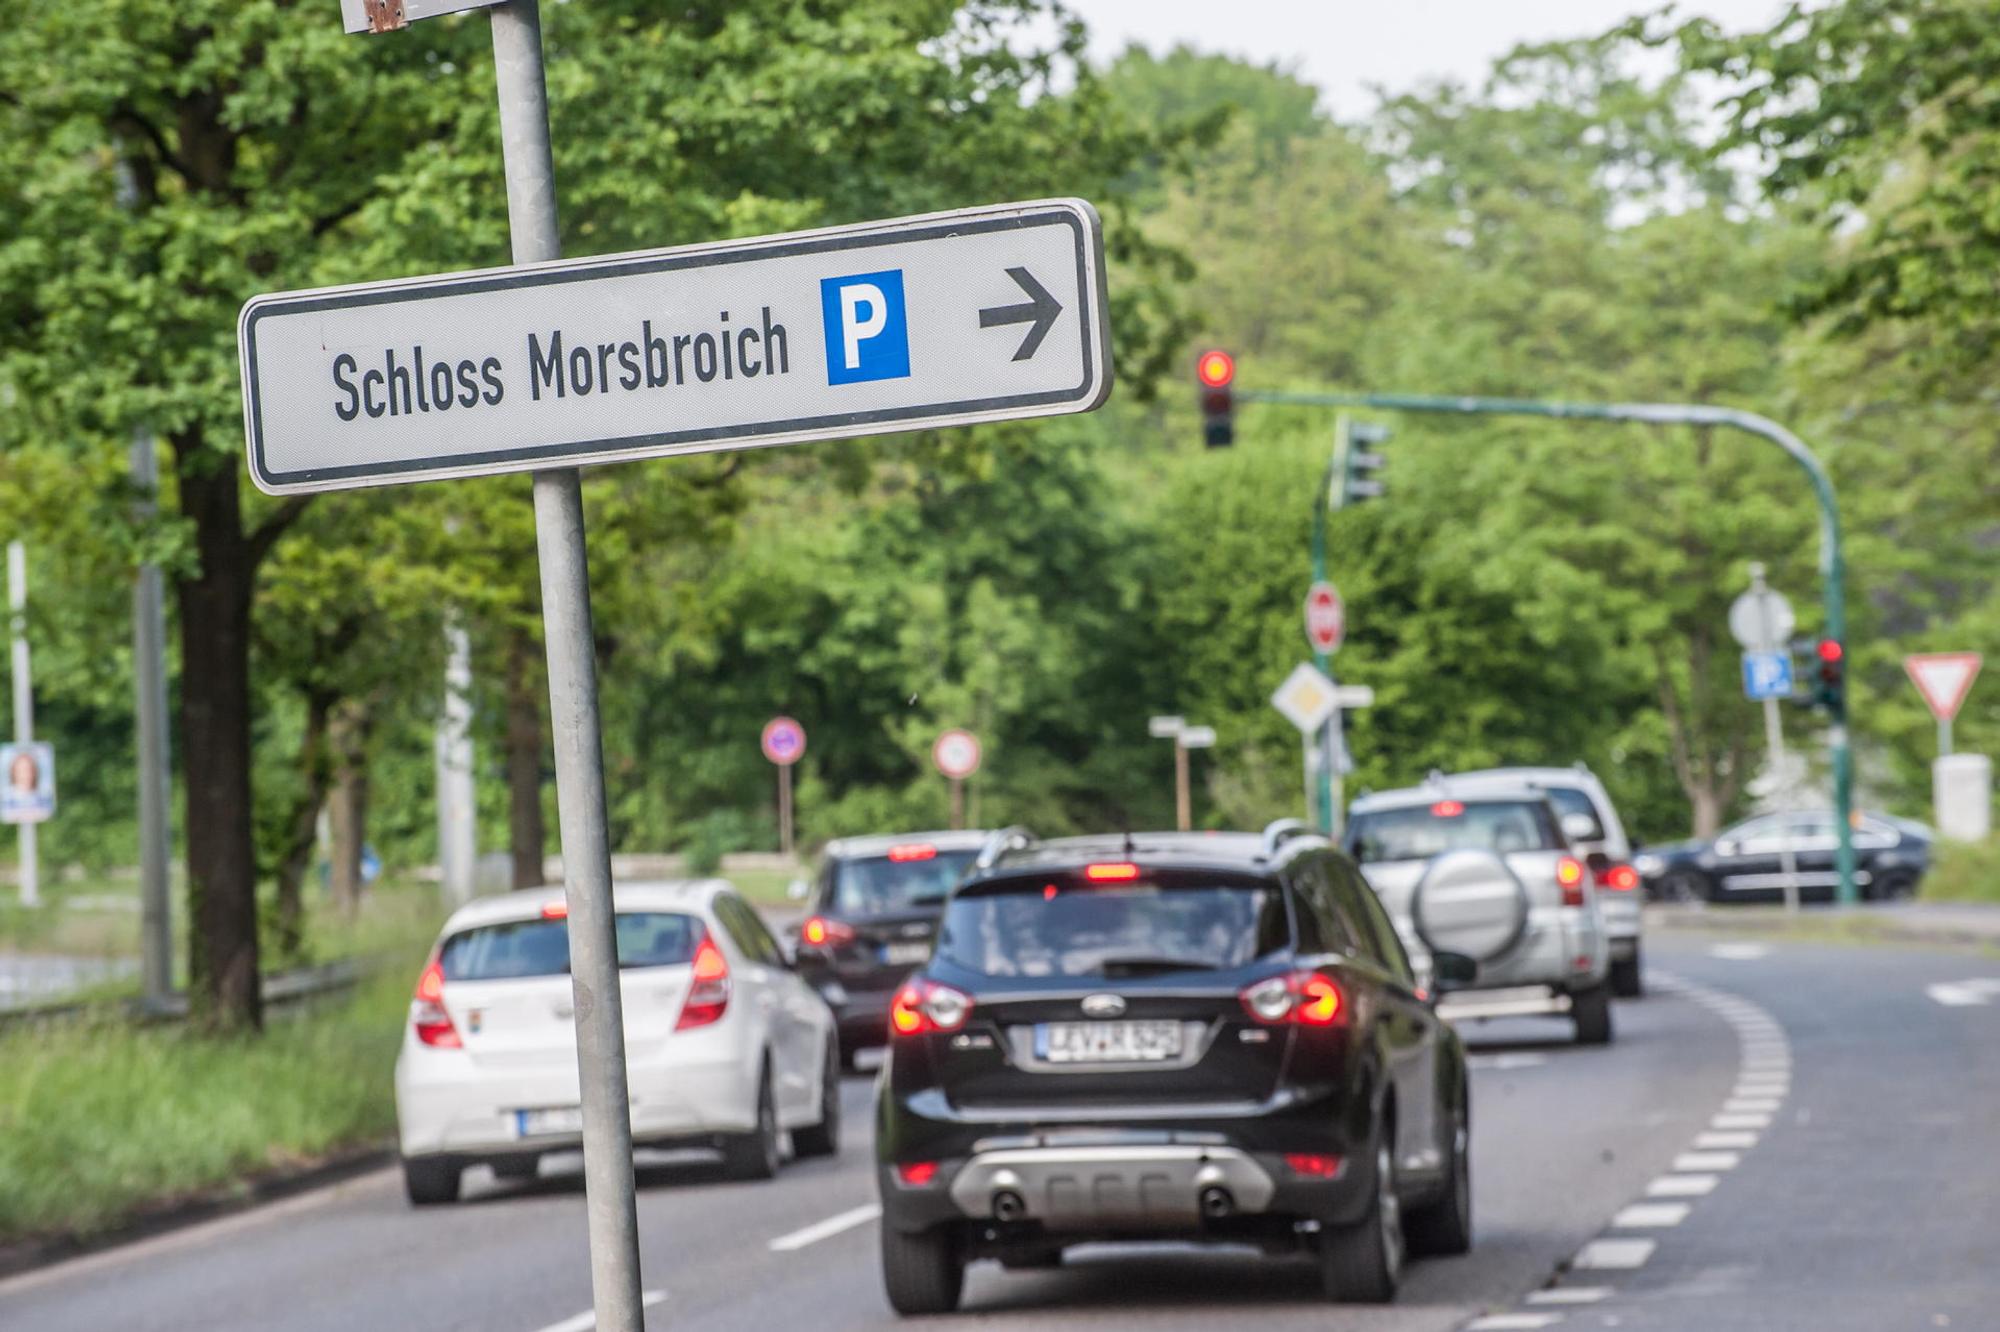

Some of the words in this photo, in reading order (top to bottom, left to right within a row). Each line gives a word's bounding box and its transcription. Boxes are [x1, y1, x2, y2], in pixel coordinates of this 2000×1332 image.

[333, 345, 504, 422] Schloss
[527, 306, 789, 401] Morsbroich
[839, 283, 887, 369] P
